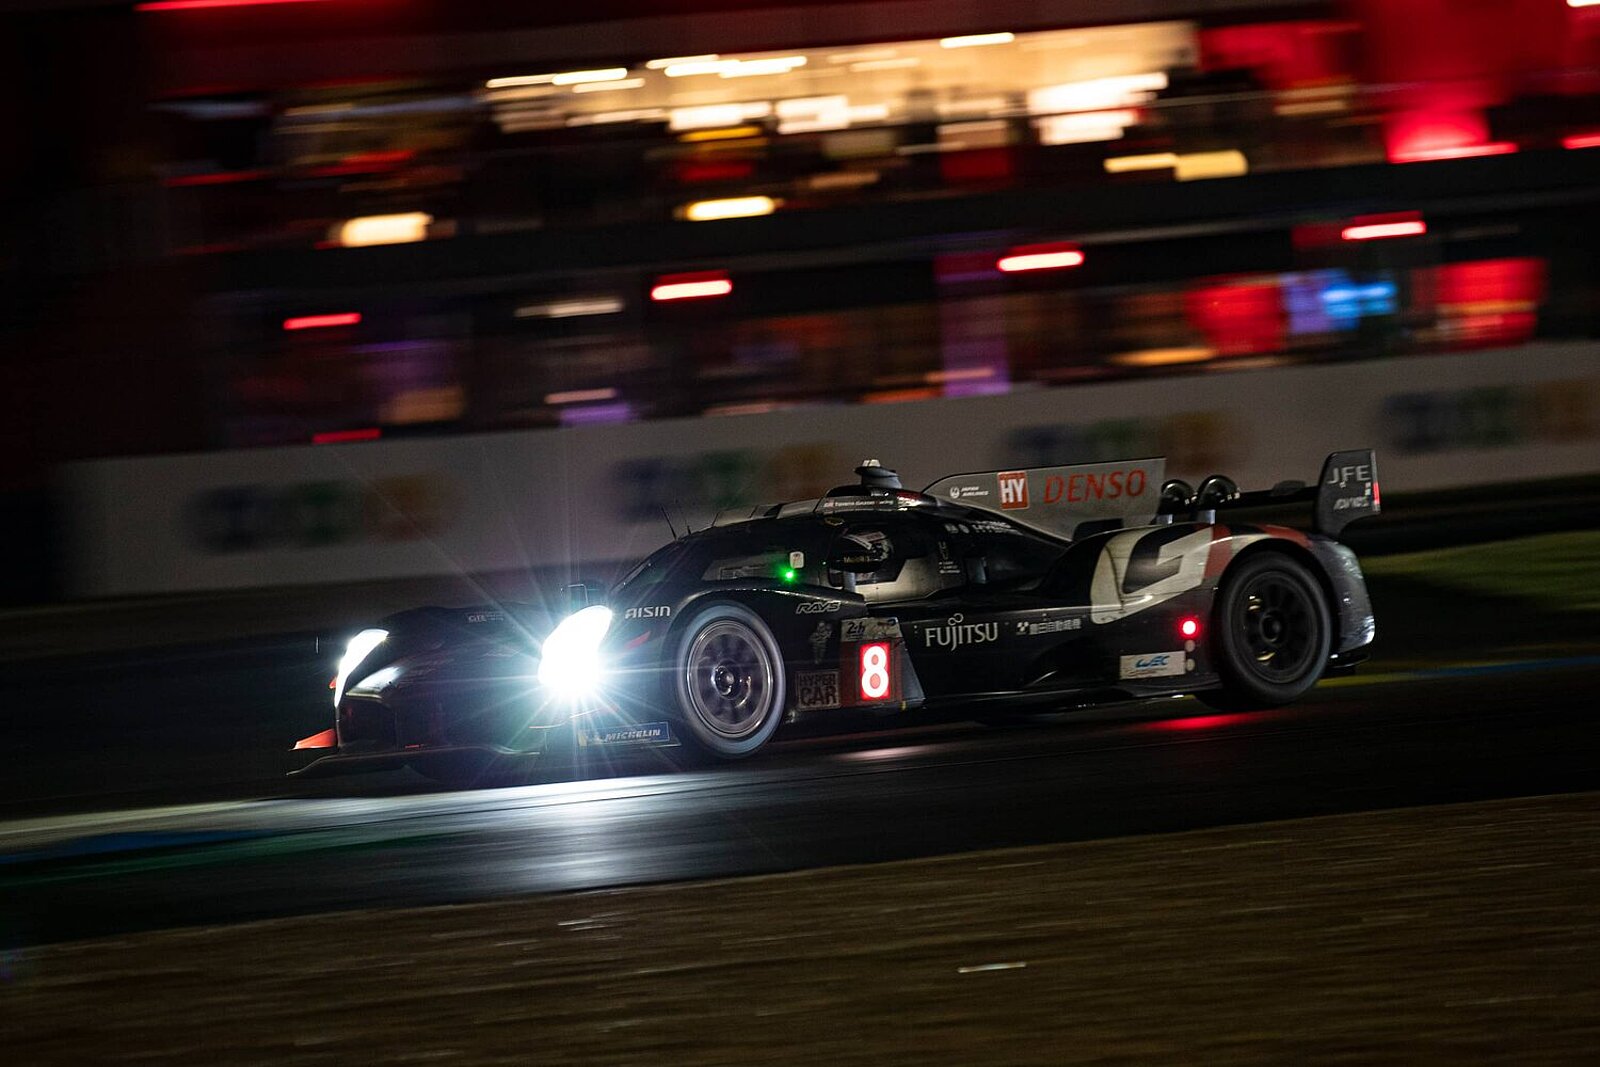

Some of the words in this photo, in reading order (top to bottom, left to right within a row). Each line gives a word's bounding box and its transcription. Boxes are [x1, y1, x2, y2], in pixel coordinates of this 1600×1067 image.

[1326, 465, 1371, 484] JFE
[1000, 477, 1025, 503] HY
[1043, 470, 1147, 504] DENSO
[626, 605, 671, 619] AISIN
[796, 601, 842, 615] RAYS
[924, 615, 999, 651] FUJITSU
[798, 672, 837, 687] HYPER
[861, 645, 890, 698] 8
[800, 686, 837, 706] CAR
[605, 728, 661, 742] MICHELIN
